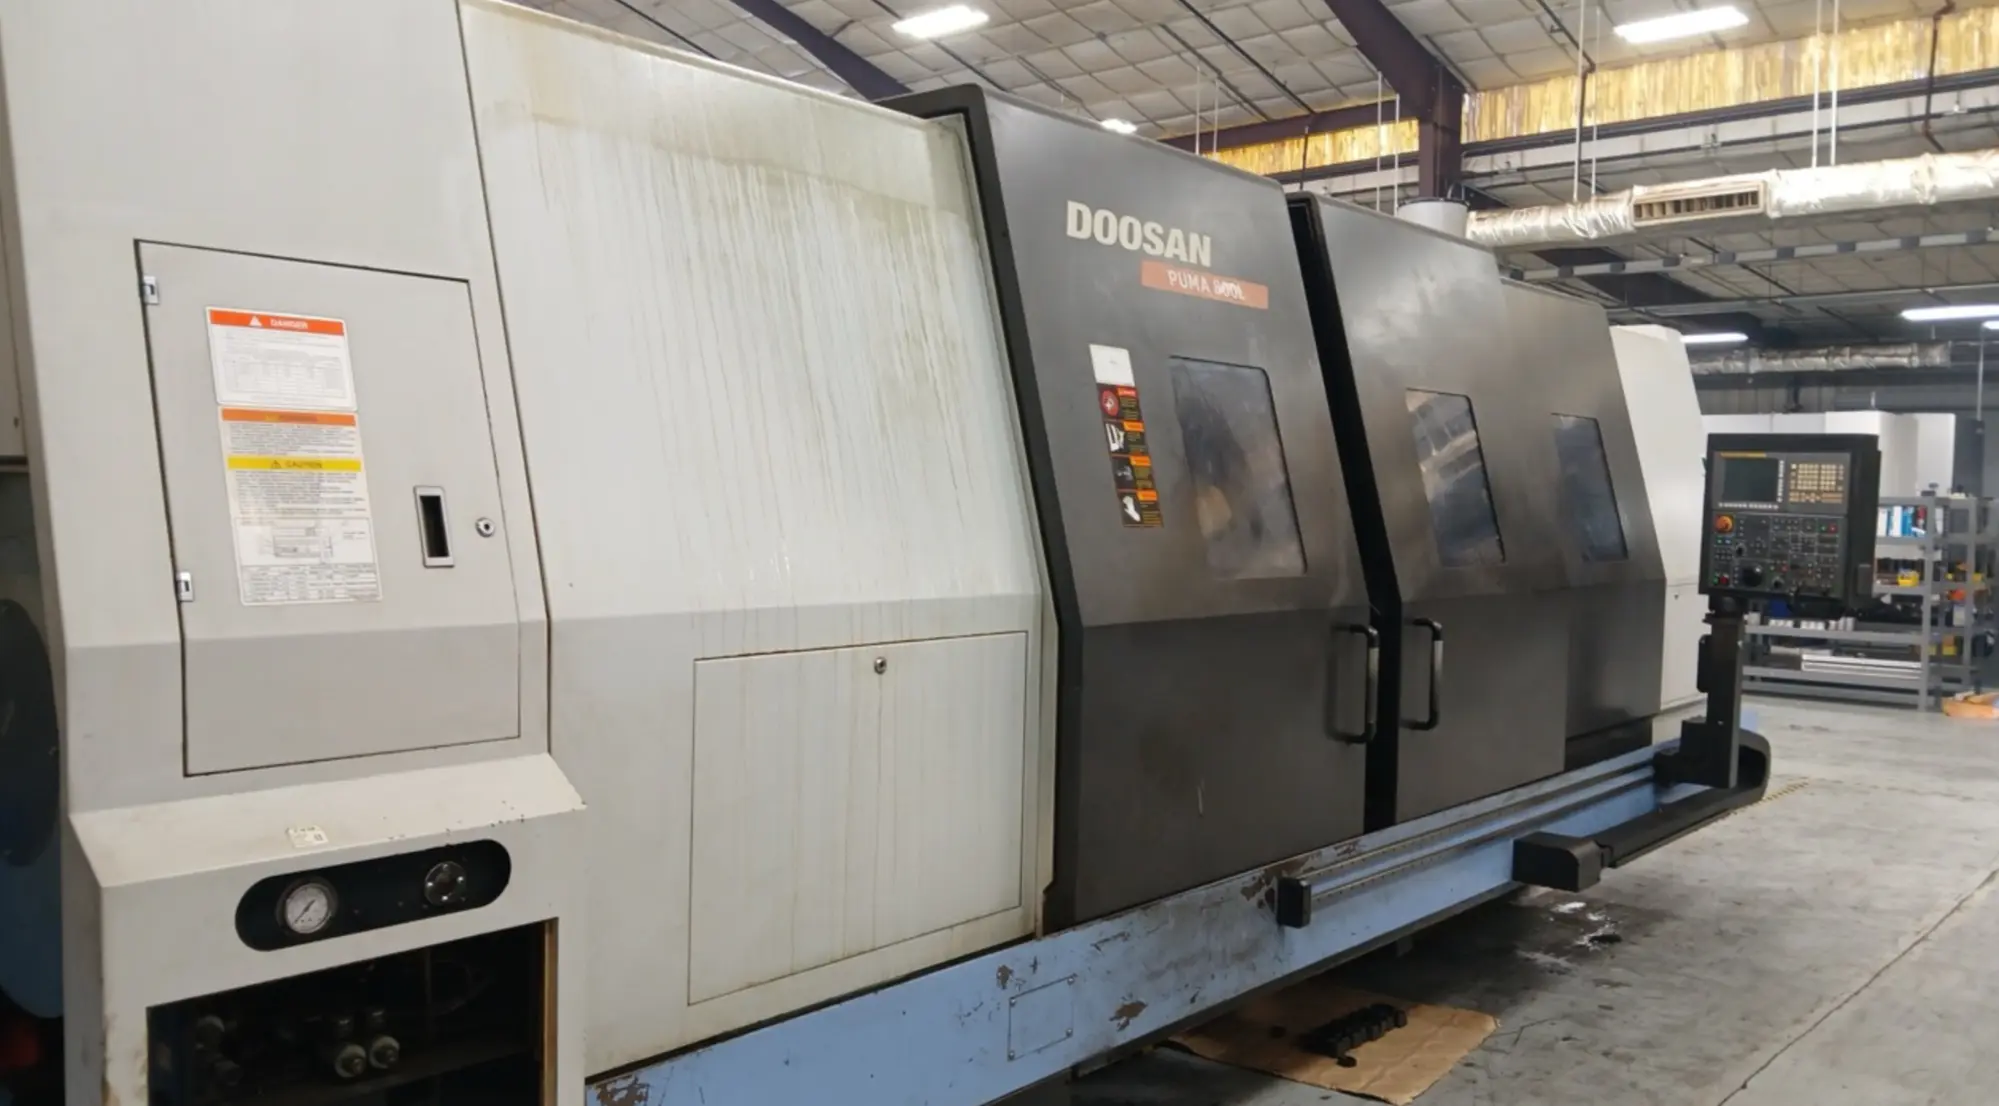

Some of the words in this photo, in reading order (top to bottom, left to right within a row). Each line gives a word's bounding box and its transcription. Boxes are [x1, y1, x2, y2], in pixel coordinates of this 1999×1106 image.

[1066, 200, 1212, 267] DOOSAN
[1167, 269, 1211, 294] PUMA
[270, 318, 308, 330] DANGER
